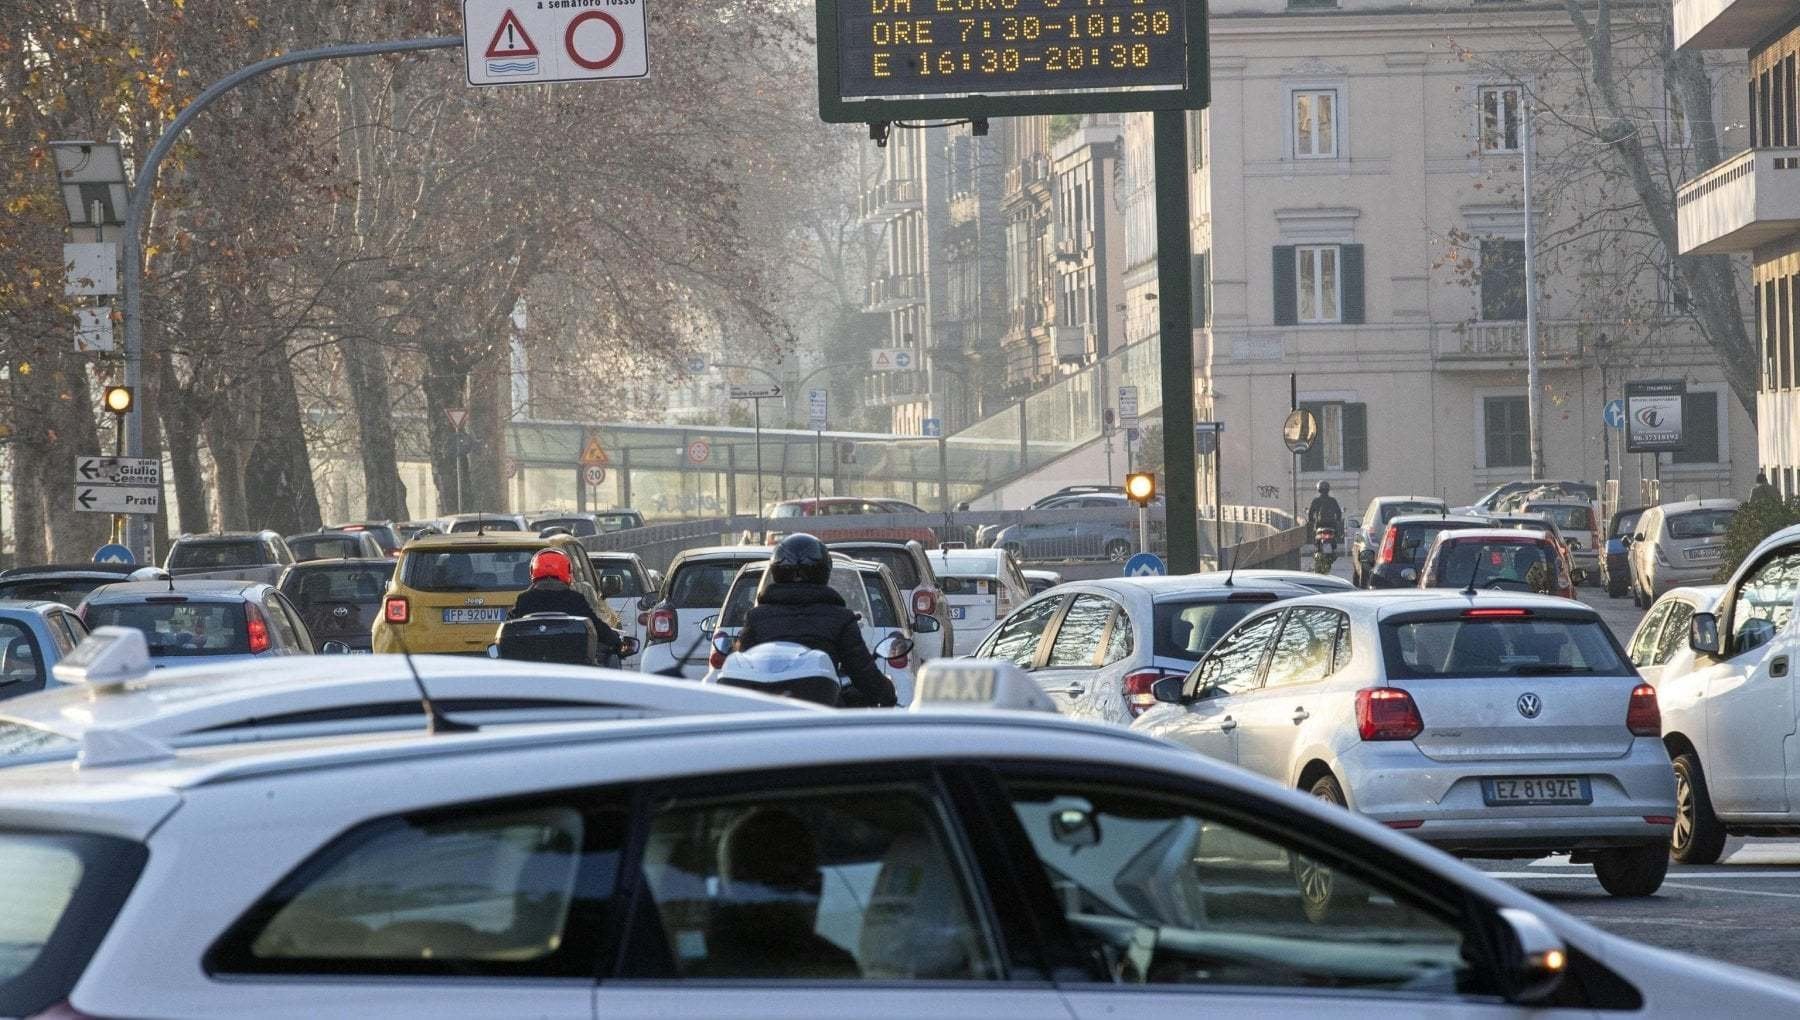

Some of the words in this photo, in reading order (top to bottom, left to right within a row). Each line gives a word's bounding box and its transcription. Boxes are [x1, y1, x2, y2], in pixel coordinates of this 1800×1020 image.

[873, 20, 932, 44] ORE
[958, 11, 1169, 42] 7:30-10:30
[873, 53, 890, 76] E
[919, 44, 1149, 74] 16:30-20:30
[120, 465, 157, 476] Giulio
[589, 470, 601, 480] 20
[126, 495, 156, 505] Prati
[451, 609, 463, 620] FP
[922, 670, 994, 700] TAXI
[1496, 781, 1519, 798] EZ
[1524, 780, 1577, 798] 819ZF
